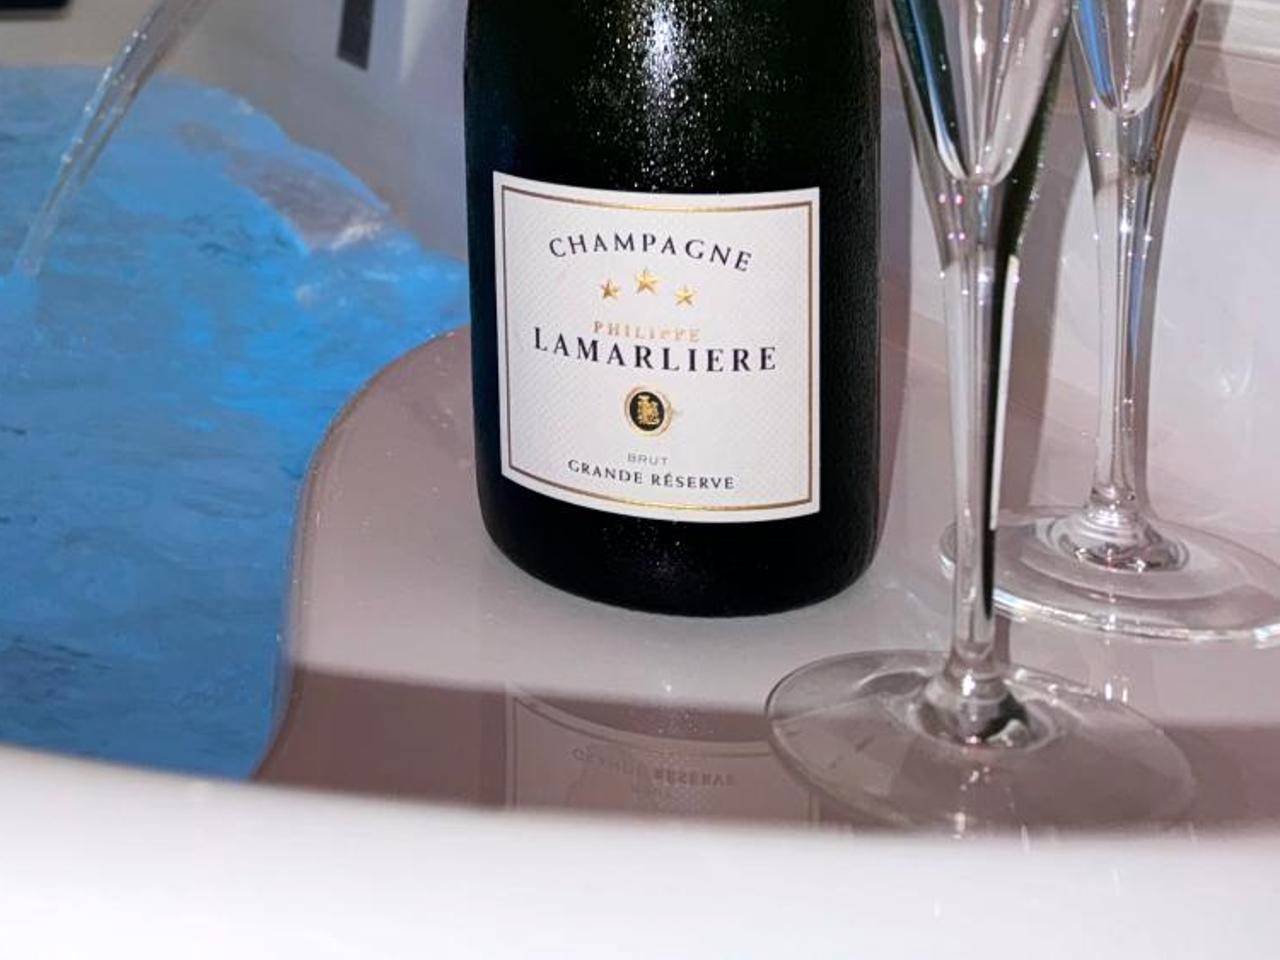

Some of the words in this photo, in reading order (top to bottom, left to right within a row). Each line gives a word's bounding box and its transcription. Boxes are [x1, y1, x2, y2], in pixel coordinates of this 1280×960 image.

[548, 232, 753, 273] CHAMPAGNE
[593, 320, 701, 343] PHILIPPE
[533, 326, 777, 373] LAMARLIERE
[568, 459, 644, 485] GRANDE
[651, 471, 735, 490] RÉSERVE
[627, 452, 669, 466] BRUT
